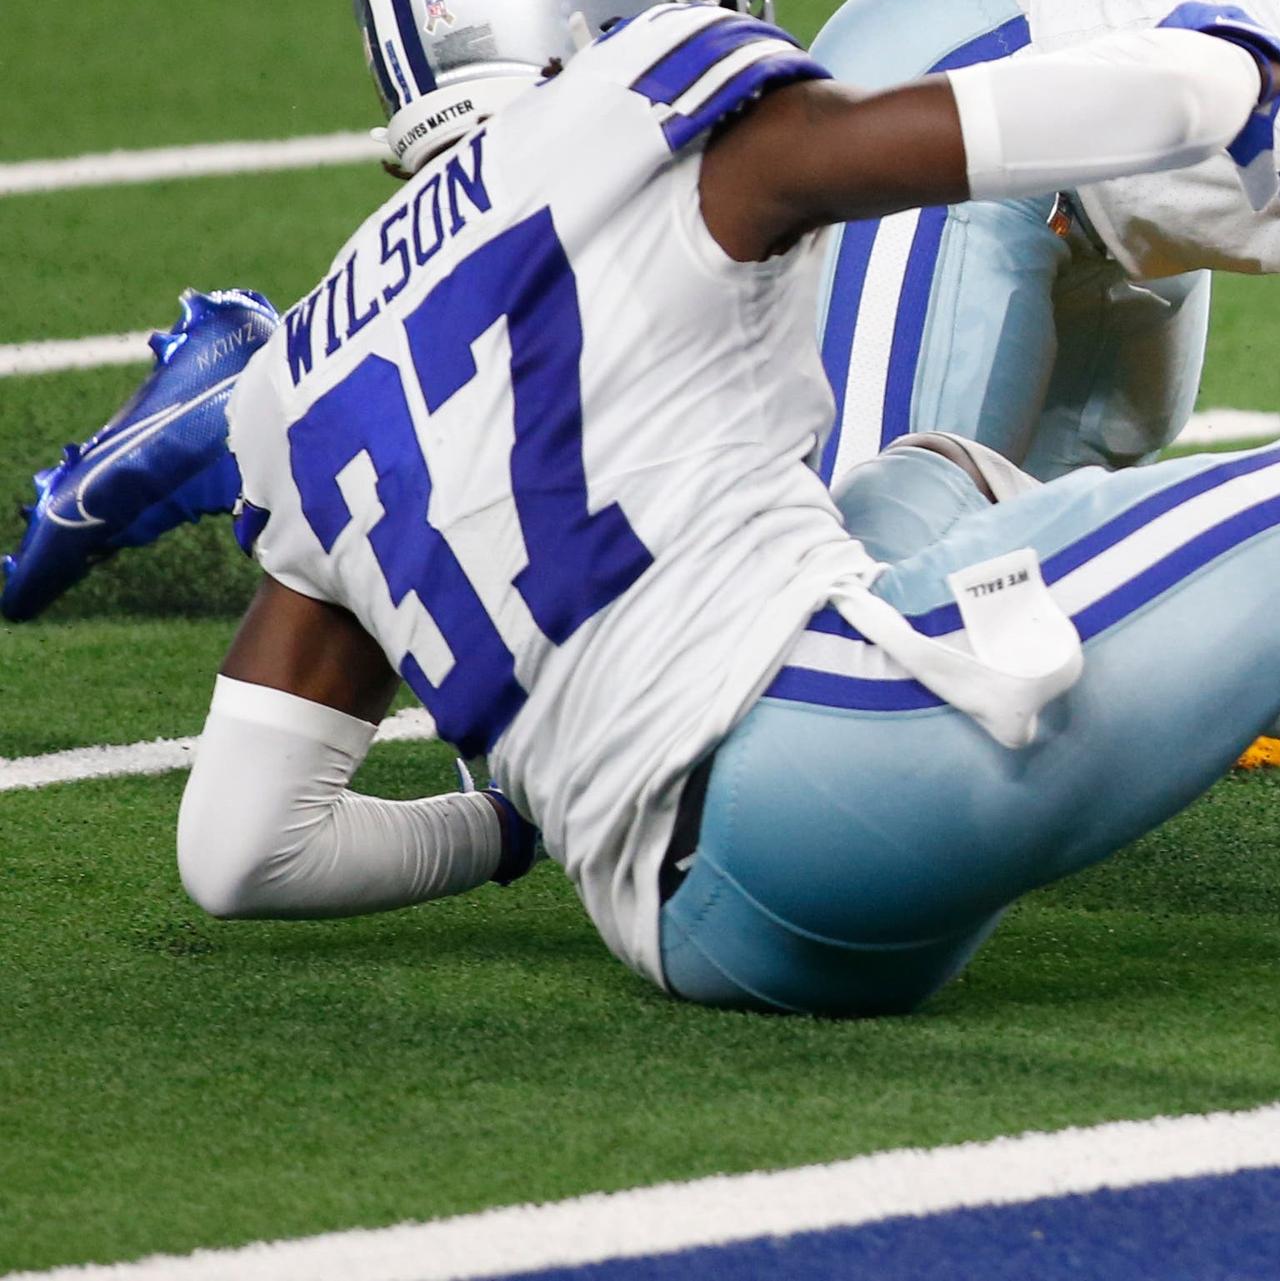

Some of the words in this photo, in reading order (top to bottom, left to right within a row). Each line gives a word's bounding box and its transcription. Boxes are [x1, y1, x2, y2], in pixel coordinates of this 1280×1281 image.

[406, 121, 429, 146] LIVES
[428, 98, 475, 131] MATTER
[284, 128, 491, 386] WILSON
[285, 204, 655, 762] 37
